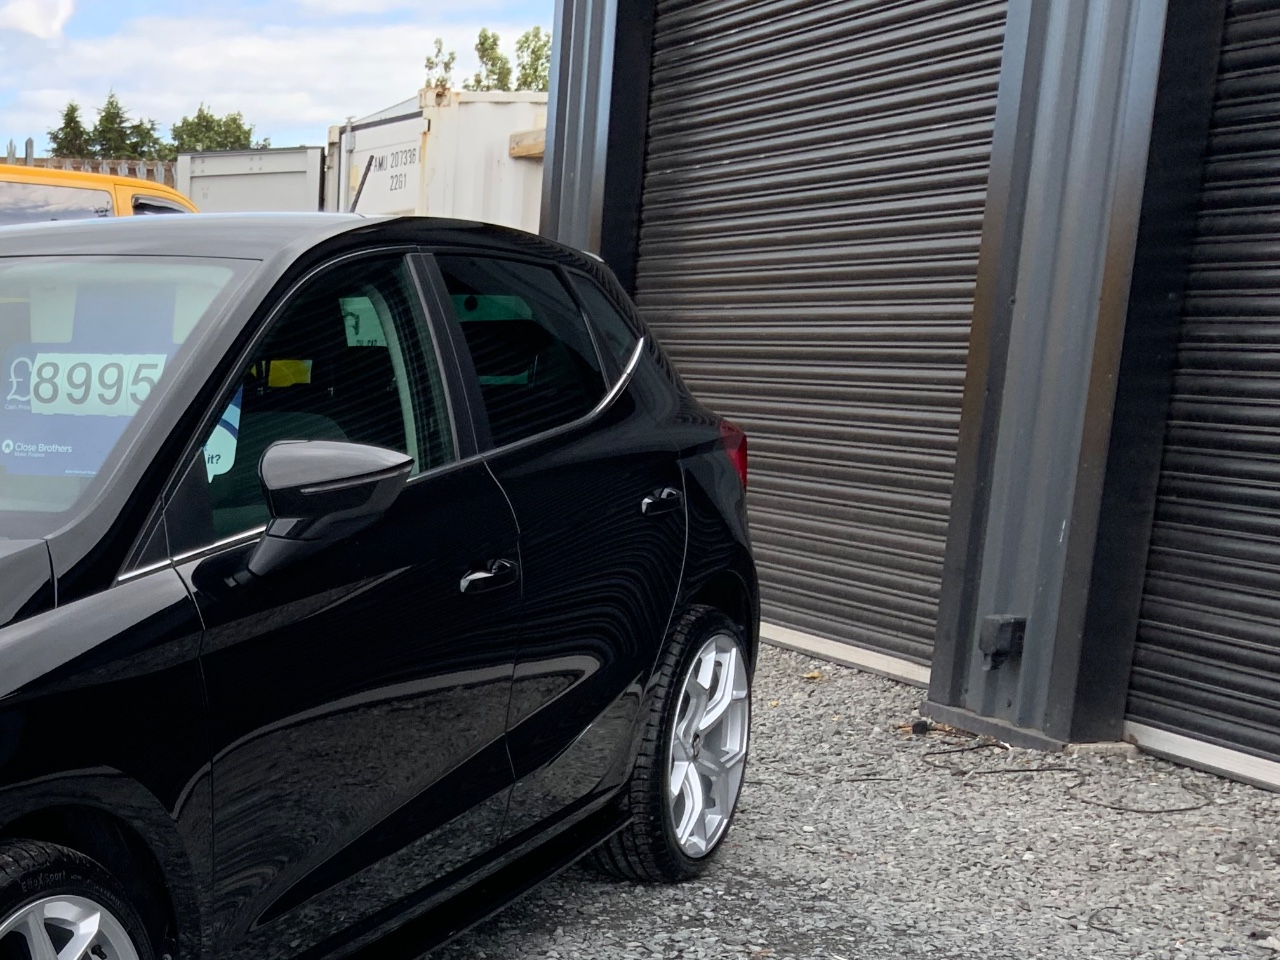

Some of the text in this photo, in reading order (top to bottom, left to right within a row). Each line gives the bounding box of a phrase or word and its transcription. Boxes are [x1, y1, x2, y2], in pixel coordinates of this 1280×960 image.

[370, 154, 388, 173] AMU
[15, 442, 73, 454] Close Brothers
[207, 454, 222, 465] it?
